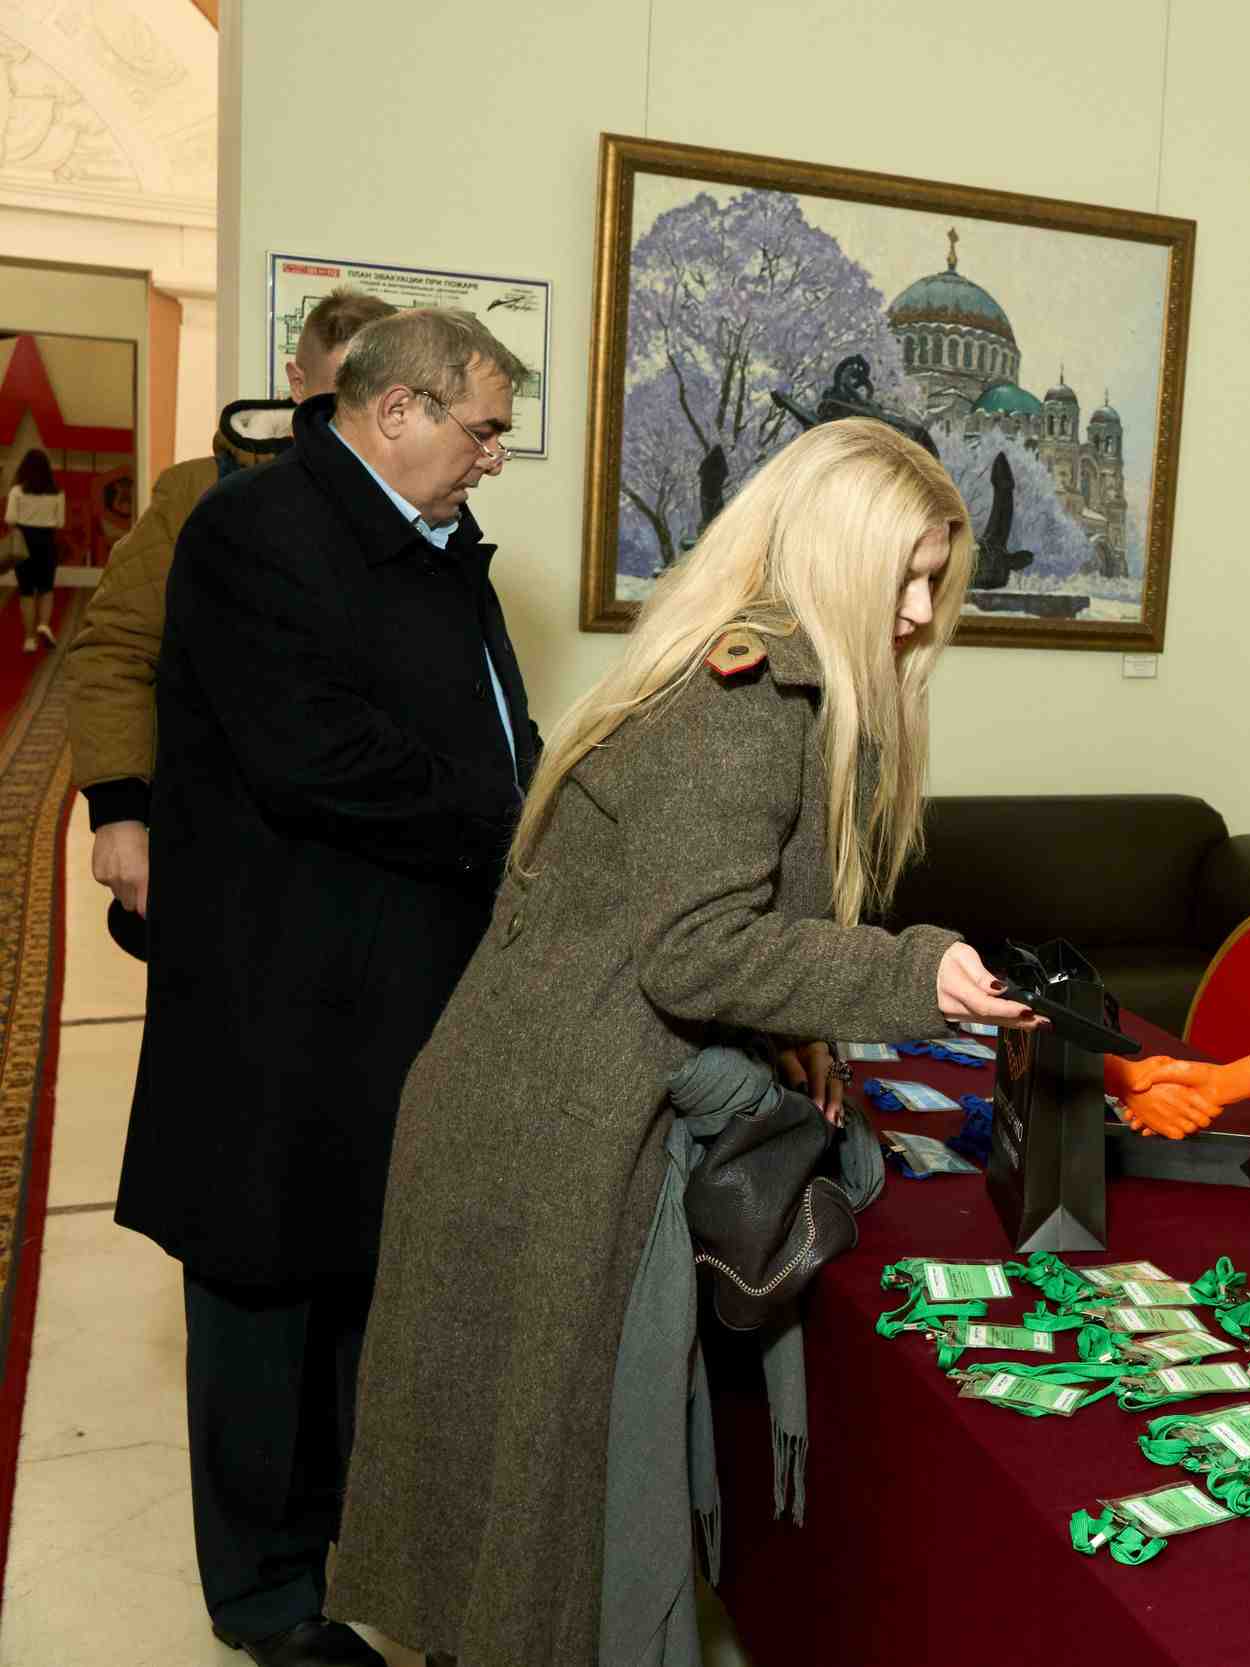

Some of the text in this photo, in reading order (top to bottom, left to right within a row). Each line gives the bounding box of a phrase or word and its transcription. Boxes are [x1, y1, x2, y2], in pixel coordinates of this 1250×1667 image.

[348, 270, 372, 280] ПЛАН
[374, 272, 423, 285] ЭВАКУАЦИИ
[425, 277, 442, 286] ПРИ
[444, 279, 479, 290] ПОЖАРЕ
